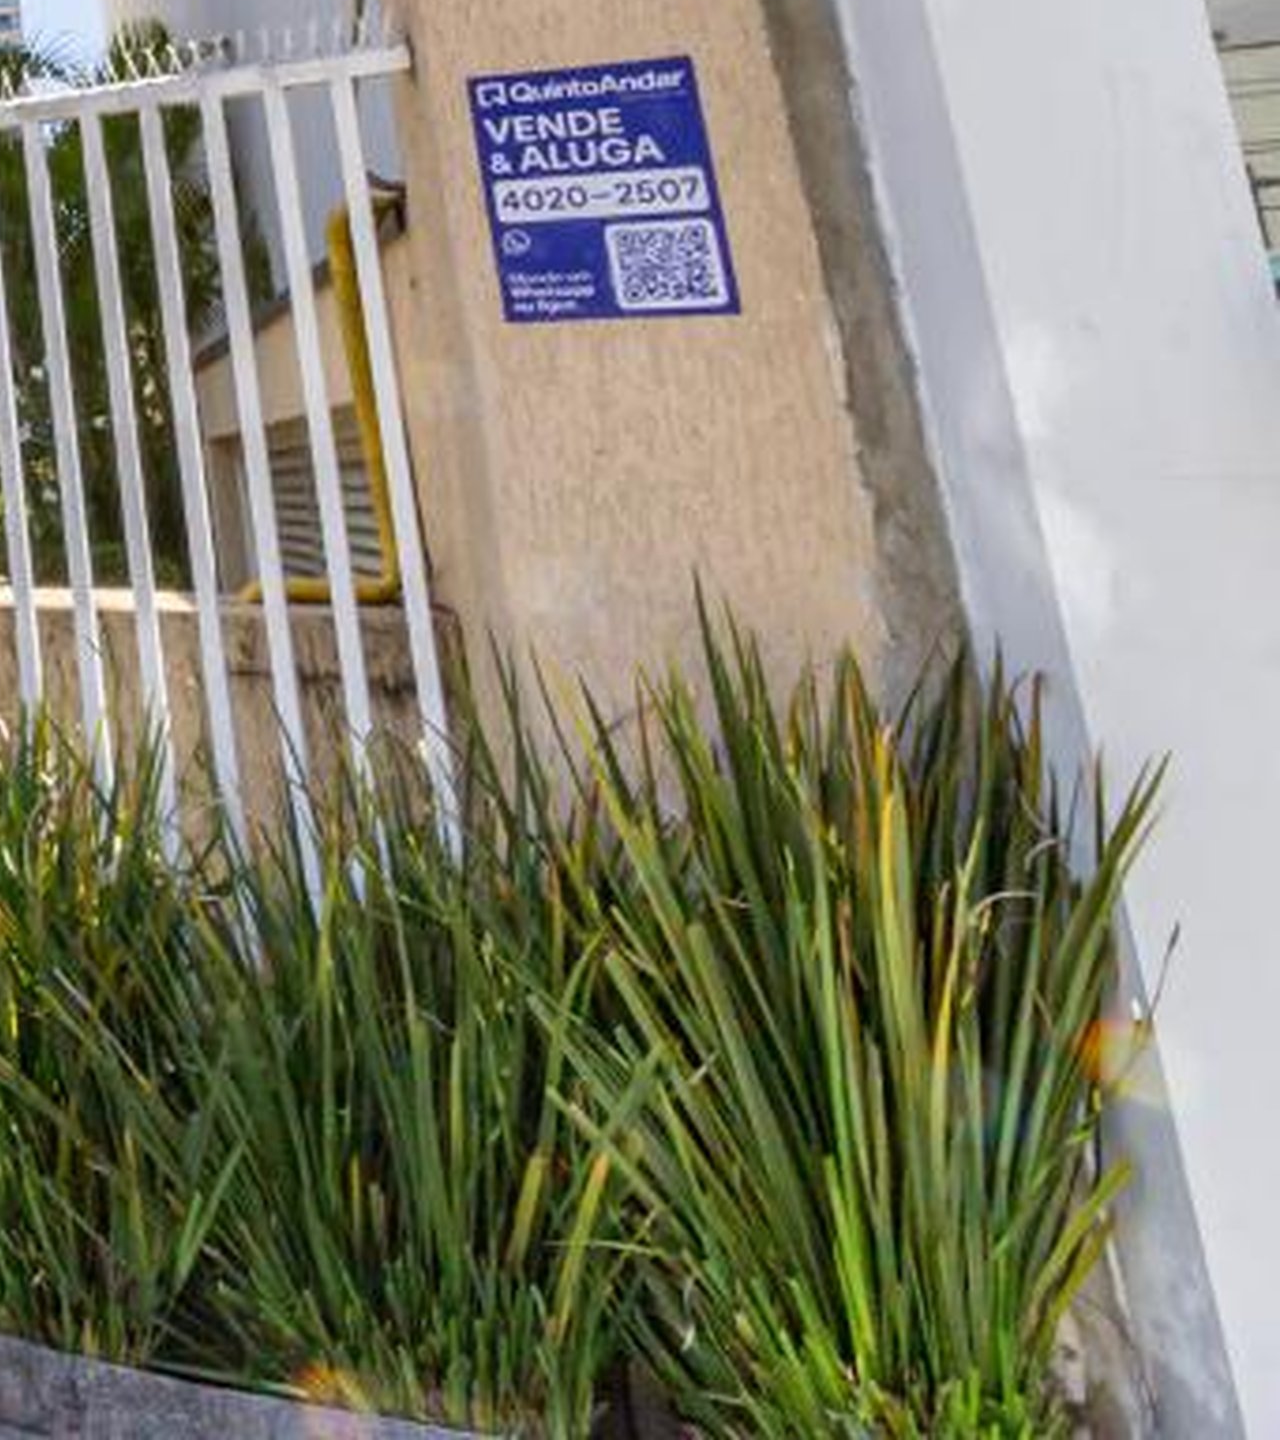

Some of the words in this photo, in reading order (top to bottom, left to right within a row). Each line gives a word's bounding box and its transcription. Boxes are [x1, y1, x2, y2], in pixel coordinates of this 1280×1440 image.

[508, 69, 686, 103] QuintoAndar
[483, 107, 625, 145] VENDE
[490, 152, 514, 175] &
[520, 133, 667, 174] ALUGA
[501, 175, 700, 212] 4020-2507
